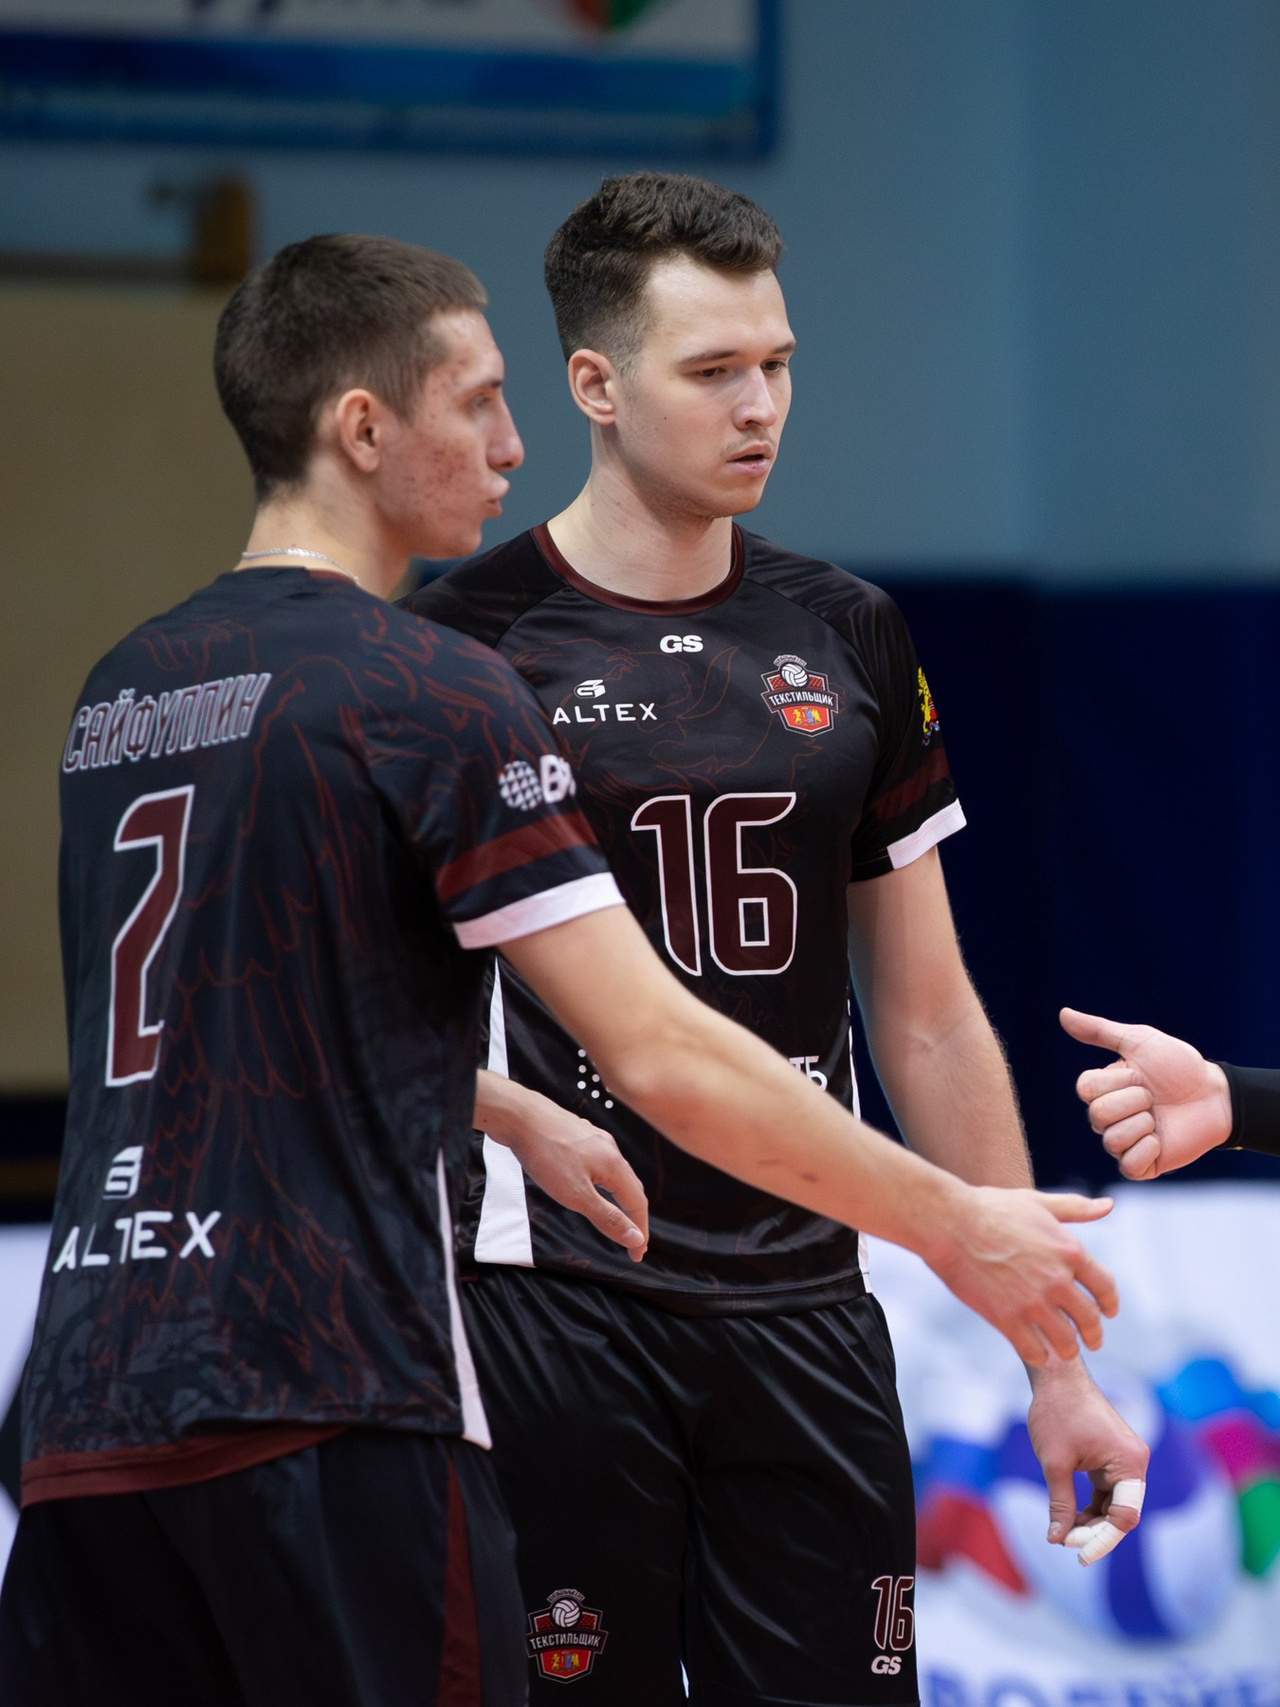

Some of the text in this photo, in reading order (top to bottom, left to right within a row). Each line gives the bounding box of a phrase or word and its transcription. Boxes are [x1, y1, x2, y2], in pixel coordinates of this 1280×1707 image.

[660, 634, 704, 653] GS
[62, 672, 272, 773] САЙФУЛЛИН
[768, 691, 834, 707] ТЕКСТИЛЬЩИК
[630, 791, 798, 977] 16
[105, 784, 195, 1087] 2
[871, 1575, 914, 1651] 16
[529, 1633, 601, 1650] ТЕКСТИЛЬЩИК
[871, 1655, 902, 1675] GS
